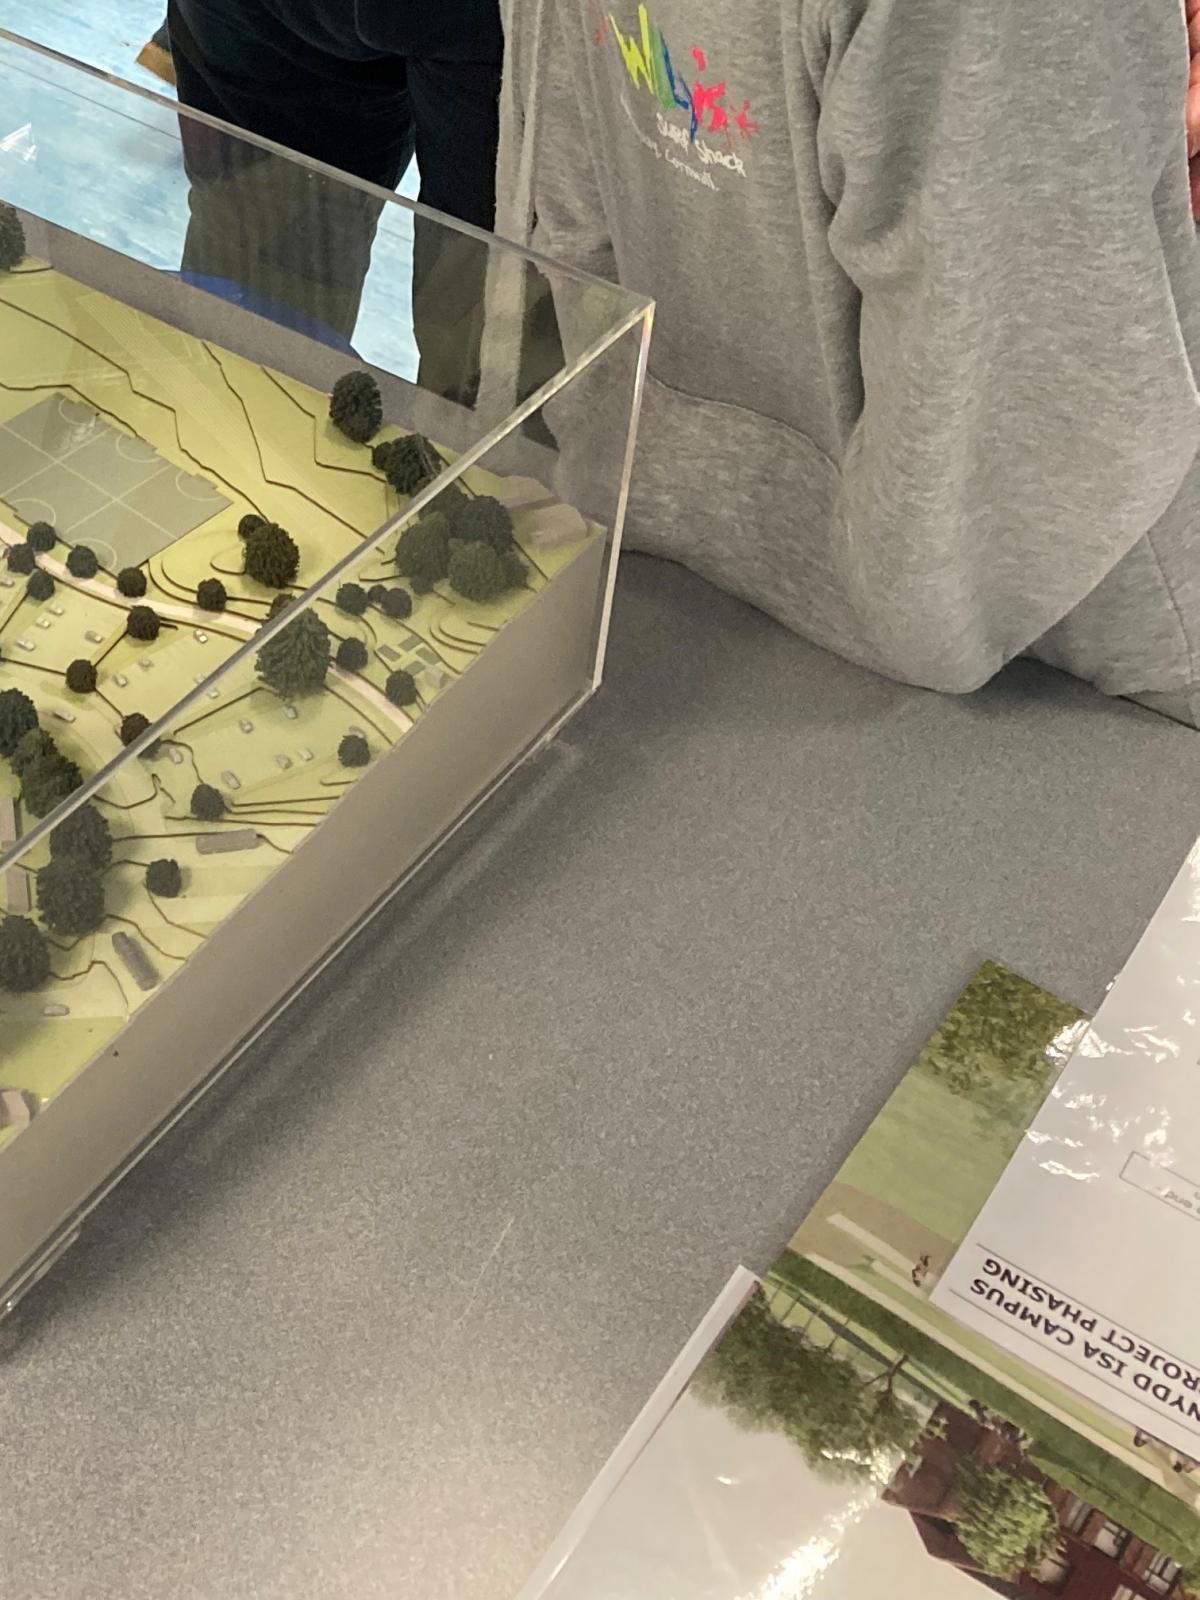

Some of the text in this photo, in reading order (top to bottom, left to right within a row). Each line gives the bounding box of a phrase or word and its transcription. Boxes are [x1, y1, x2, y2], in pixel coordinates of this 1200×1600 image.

[970, 1278, 1075, 1346] CAMPUS
[982, 1258, 1200, 1392] ROJECT PHASING
[1083, 1340, 1129, 1378] ISA
